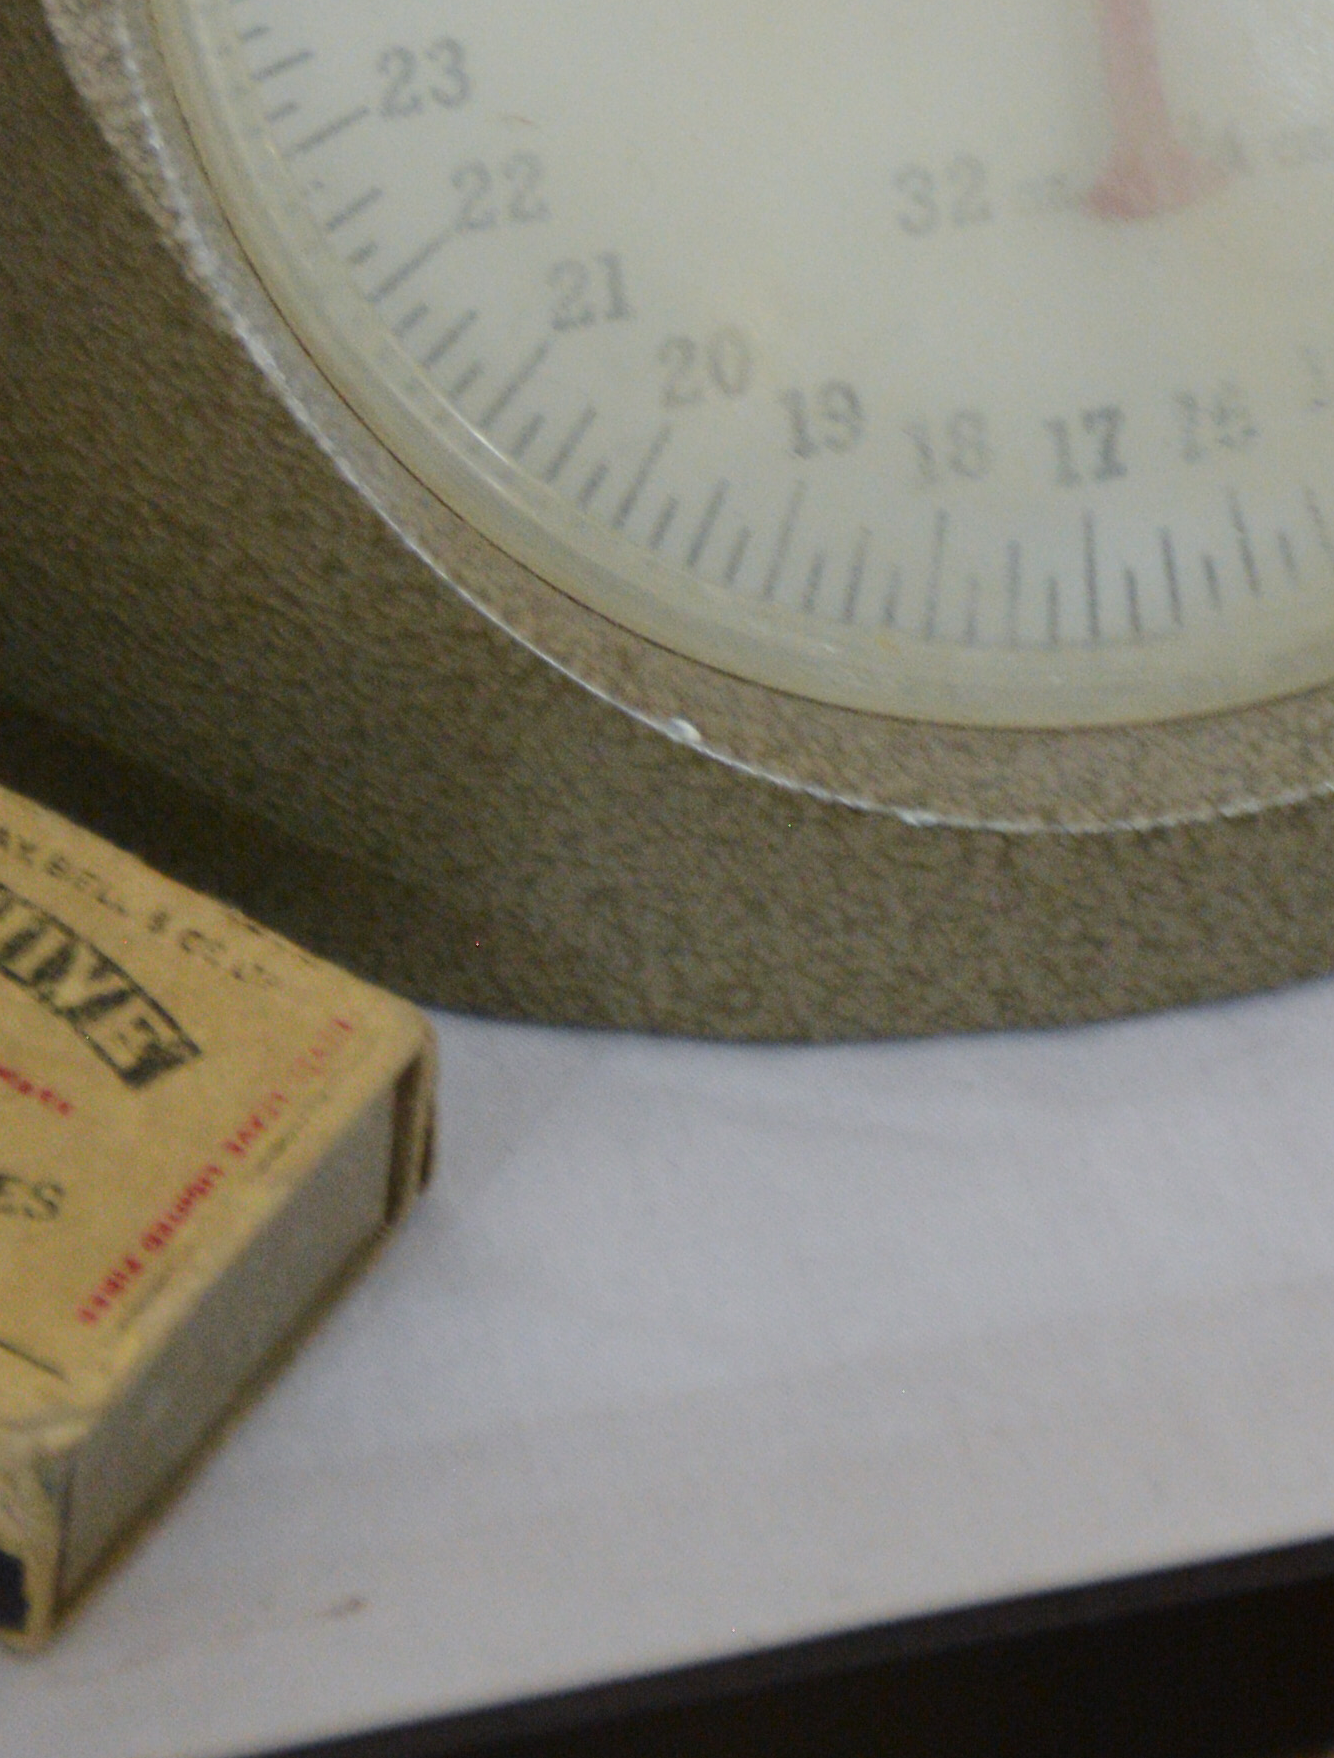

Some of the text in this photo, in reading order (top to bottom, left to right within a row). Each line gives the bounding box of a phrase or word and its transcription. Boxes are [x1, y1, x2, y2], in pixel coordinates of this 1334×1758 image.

[376, 36, 473, 120] 23
[452, 150, 549, 232] 22
[893, 151, 994, 239] 32
[547, 251, 633, 333] 21
[657, 323, 753, 409] 20
[779, 379, 863, 460] 19
[903, 408, 991, 491] 18
[1041, 404, 1128, 489] 17
